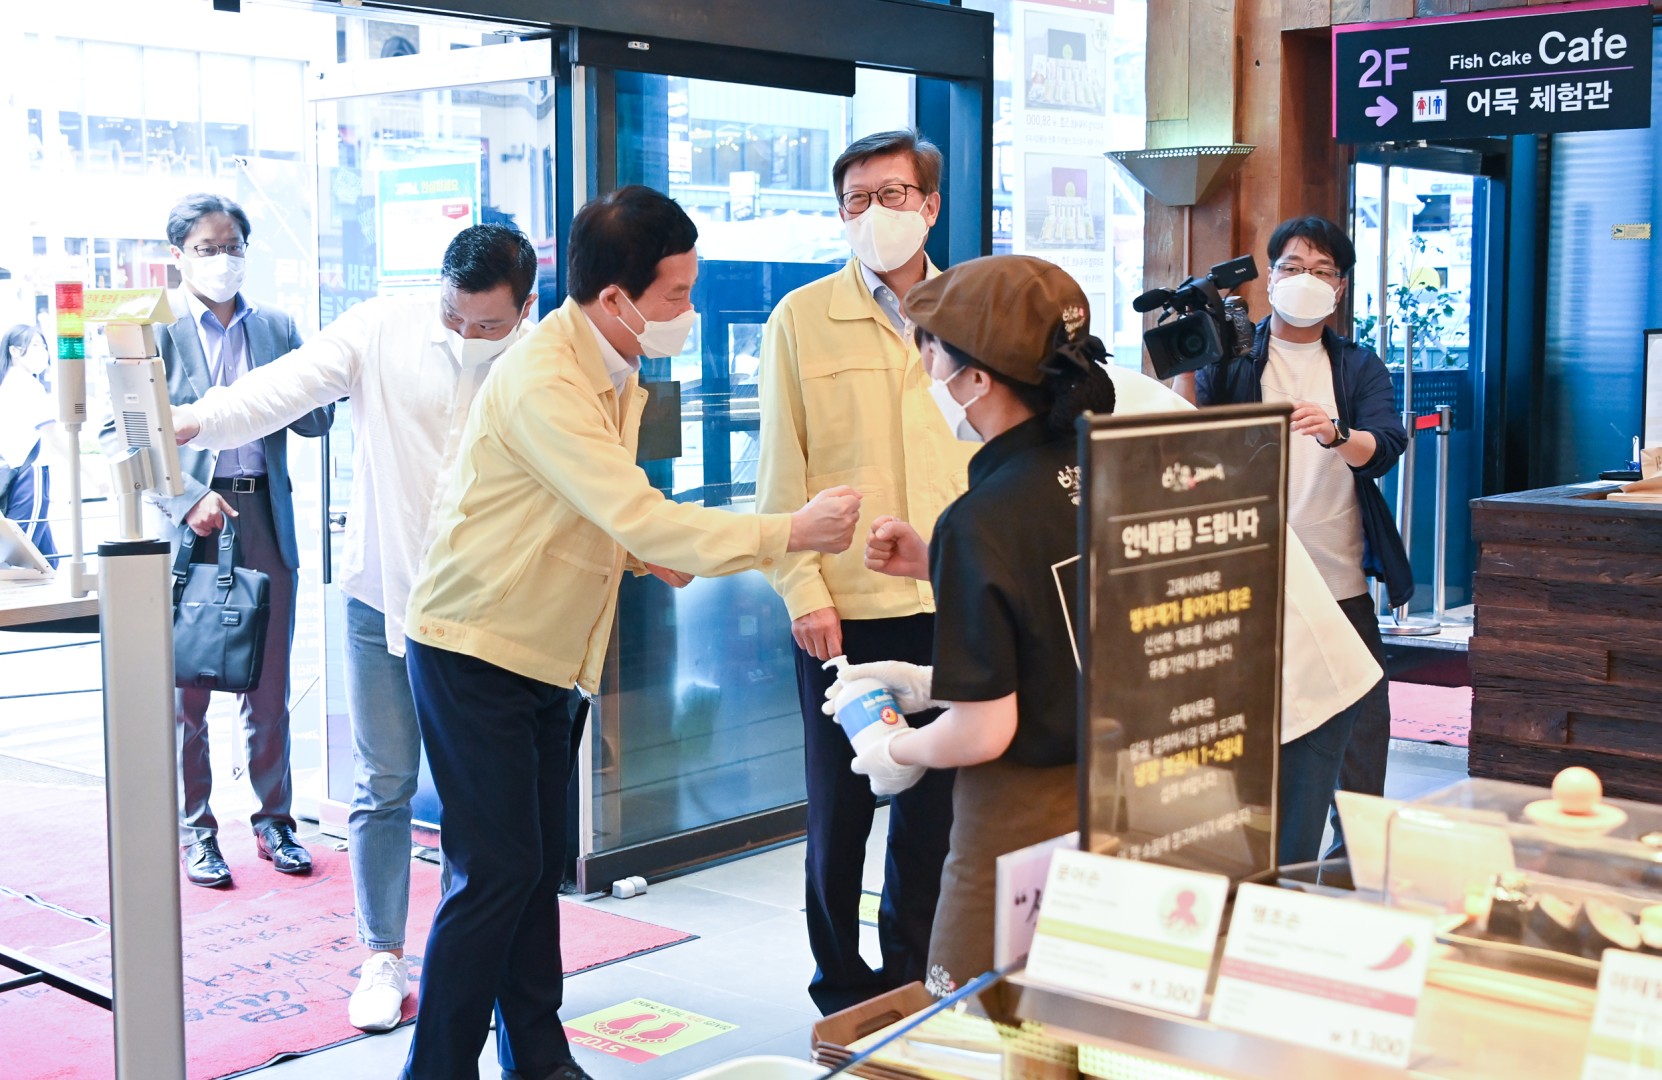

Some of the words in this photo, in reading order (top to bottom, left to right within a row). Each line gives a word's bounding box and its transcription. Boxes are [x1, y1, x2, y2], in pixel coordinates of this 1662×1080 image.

[1450, 52, 1483, 70] Fish
[1489, 51, 1532, 68] Cake
[1538, 28, 1628, 65] Cafe
[1358, 47, 1410, 88] 2F
[1466, 88, 1519, 117] 어묵
[1529, 80, 1612, 113] 체험관
[1122, 517, 1194, 559] 안내말씀
[1195, 507, 1260, 545] 드립니다
[1166, 570, 1222, 597] 고래사어묵은
[1129, 600, 1180, 633] 방부제가
[1181, 591, 1228, 623] 들어가지
[1228, 586, 1252, 613] 않은
[1144, 631, 1174, 656] 신선한
[1204, 616, 1240, 642] 사용하여
[1148, 651, 1195, 680] 유통기한이
[1170, 696, 1216, 725] 수제어묵은
[1198, 721, 1218, 744] 당부
[1133, 758, 1161, 788] 냉장
[571, 1036, 627, 1054] STOP
